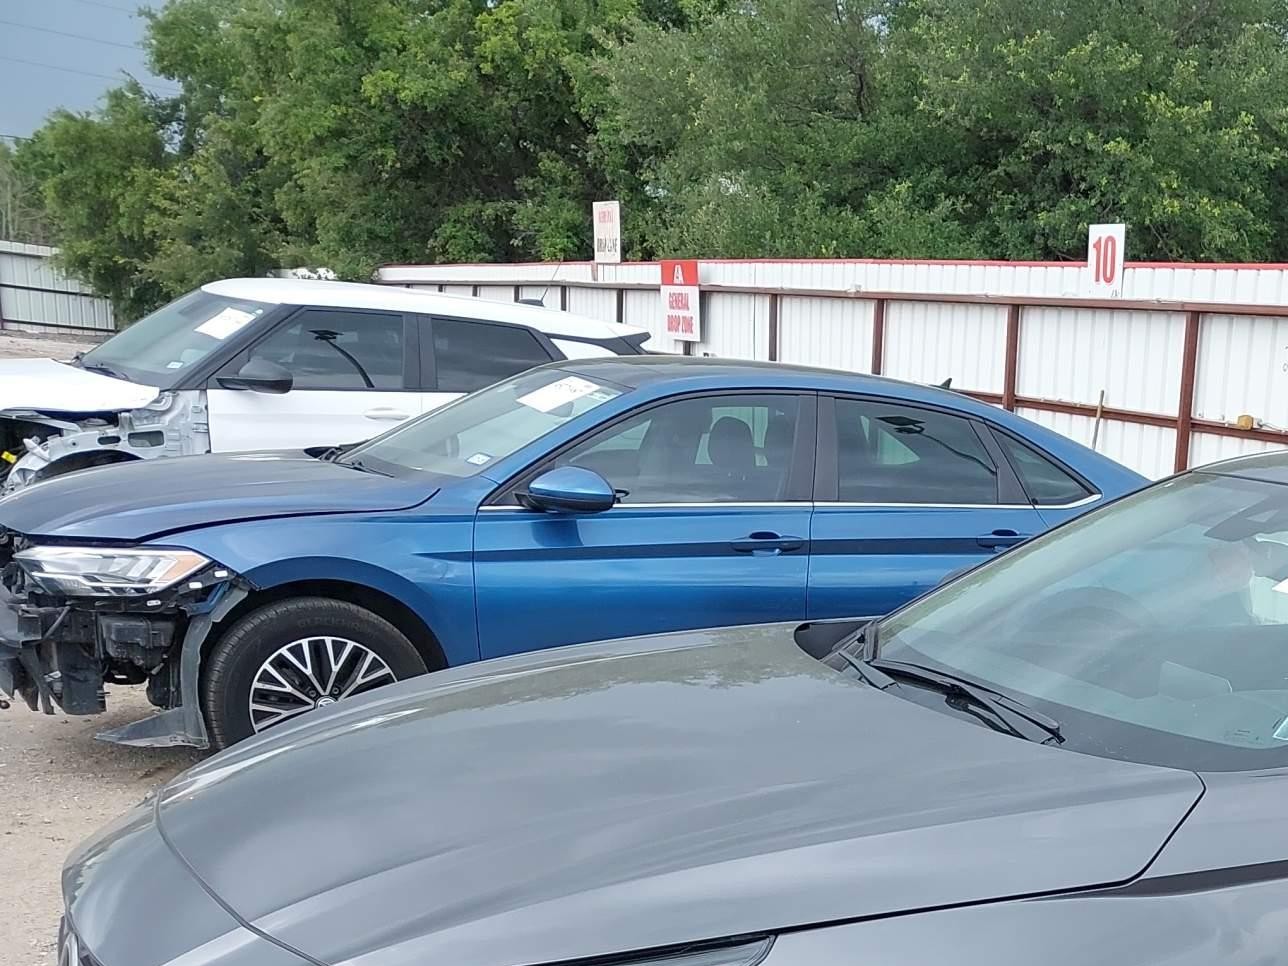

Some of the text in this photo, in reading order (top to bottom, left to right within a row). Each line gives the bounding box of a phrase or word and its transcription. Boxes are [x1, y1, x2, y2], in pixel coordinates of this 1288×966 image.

[1092, 236, 1117, 284] 10
[673, 264, 685, 285] A
[668, 292, 690, 311] GENERAL
[667, 314, 694, 334] DROP ZONE
